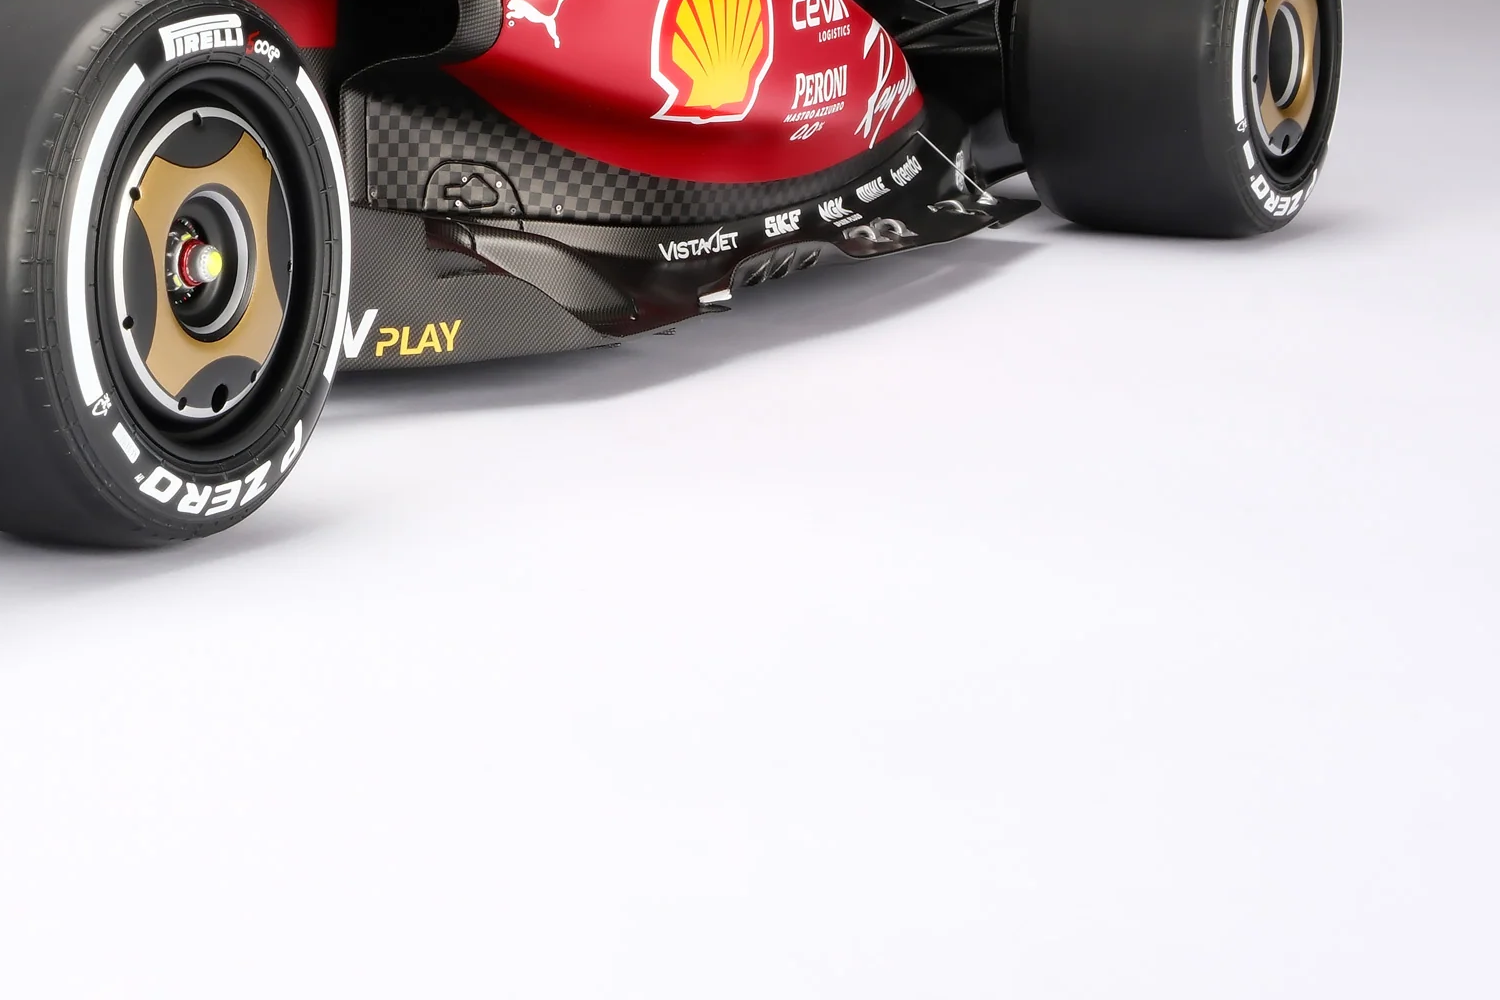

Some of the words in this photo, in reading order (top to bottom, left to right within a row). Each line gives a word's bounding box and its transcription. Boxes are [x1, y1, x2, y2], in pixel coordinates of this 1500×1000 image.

[158, 14, 244, 61] PIRELLI
[818, 24, 850, 42] LOGISTICS
[791, 64, 847, 110] PERONI
[783, 108, 815, 123] NASTRO
[814, 101, 845, 118] AZZURRO
[890, 155, 922, 187] brembo
[856, 176, 891, 203] MAHLE
[1251, 174, 1304, 216] ZERO
[764, 209, 801, 238] SKF
[817, 196, 854, 222] NGK
[375, 320, 462, 357] PLAY
[139, 460, 271, 516] ZERO
